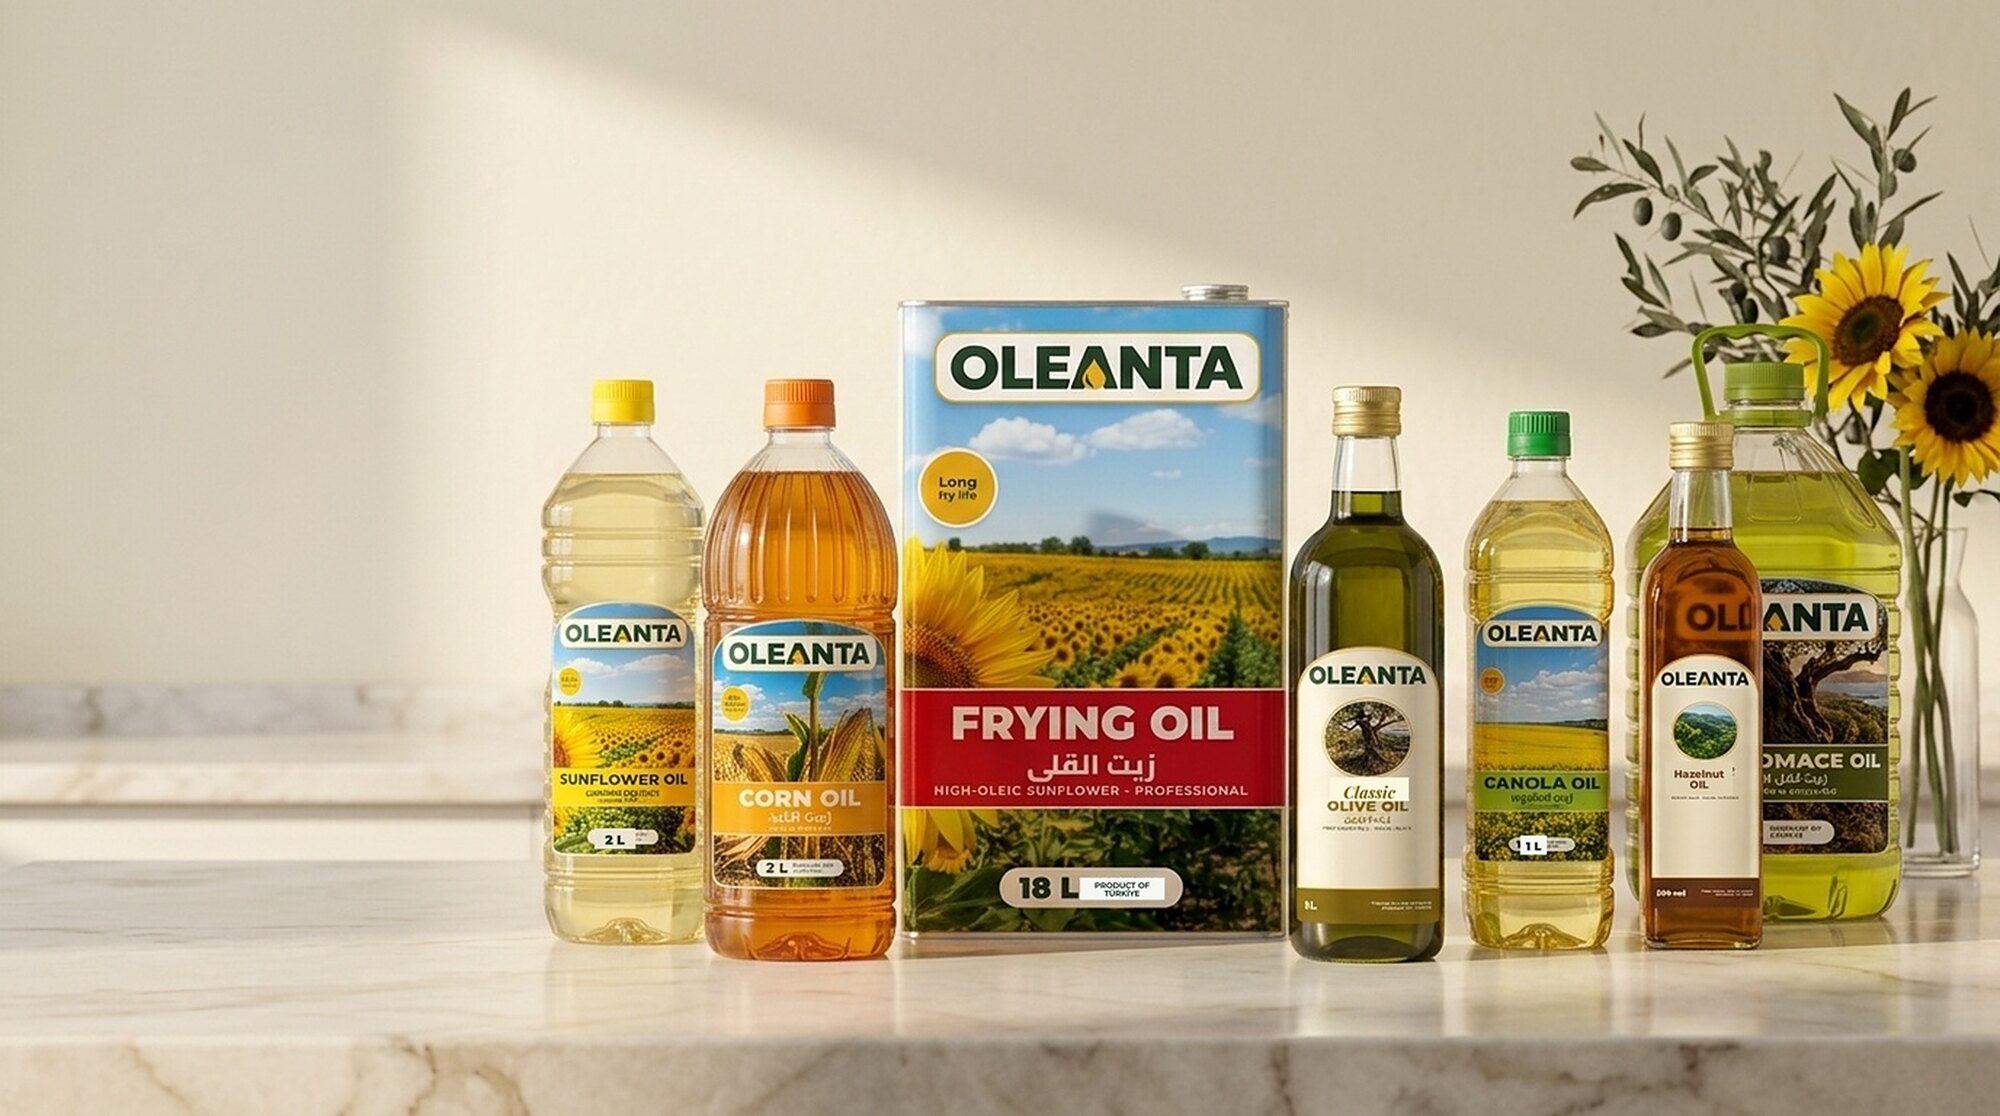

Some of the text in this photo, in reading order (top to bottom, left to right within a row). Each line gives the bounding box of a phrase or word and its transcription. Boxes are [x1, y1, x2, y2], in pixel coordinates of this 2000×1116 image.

[950, 345, 1243, 390] OLEANTA
[939, 476, 977, 491] Long
[958, 490, 978, 500] life
[565, 624, 682, 643] OLEANTA
[1488, 625, 1598, 642] OLEANTA
[729, 642, 870, 665] OLEANTA
[1309, 665, 1427, 685] OLEANTA
[1661, 671, 1749, 686] OLEANTA
[952, 705, 1235, 741] FRYING OIL
[1107, 753, 1156, 783] زيت
[1763, 753, 1881, 769] OMACE OIL
[560, 773, 688, 785] SUNFLOWER OIL
[1674, 770, 1725, 778] Hazelnut
[1484, 776, 1600, 789] CANOLA OIL
[1689, 780, 1709, 789] OIL
[739, 789, 861, 807] CORN OIL
[1135, 785, 1249, 796] PROFESSIONAL
[1344, 785, 1396, 799] Classic
[1327, 801, 1409, 812] OLIVE OIL
[605, 835, 613, 845] 2
[617, 835, 625, 845] L
[1526, 842, 1531, 851] 1
[1534, 842, 1542, 851] L
[766, 863, 774, 873] 2
[780, 863, 788, 873] L
[1018, 876, 1080, 900] 18 L
